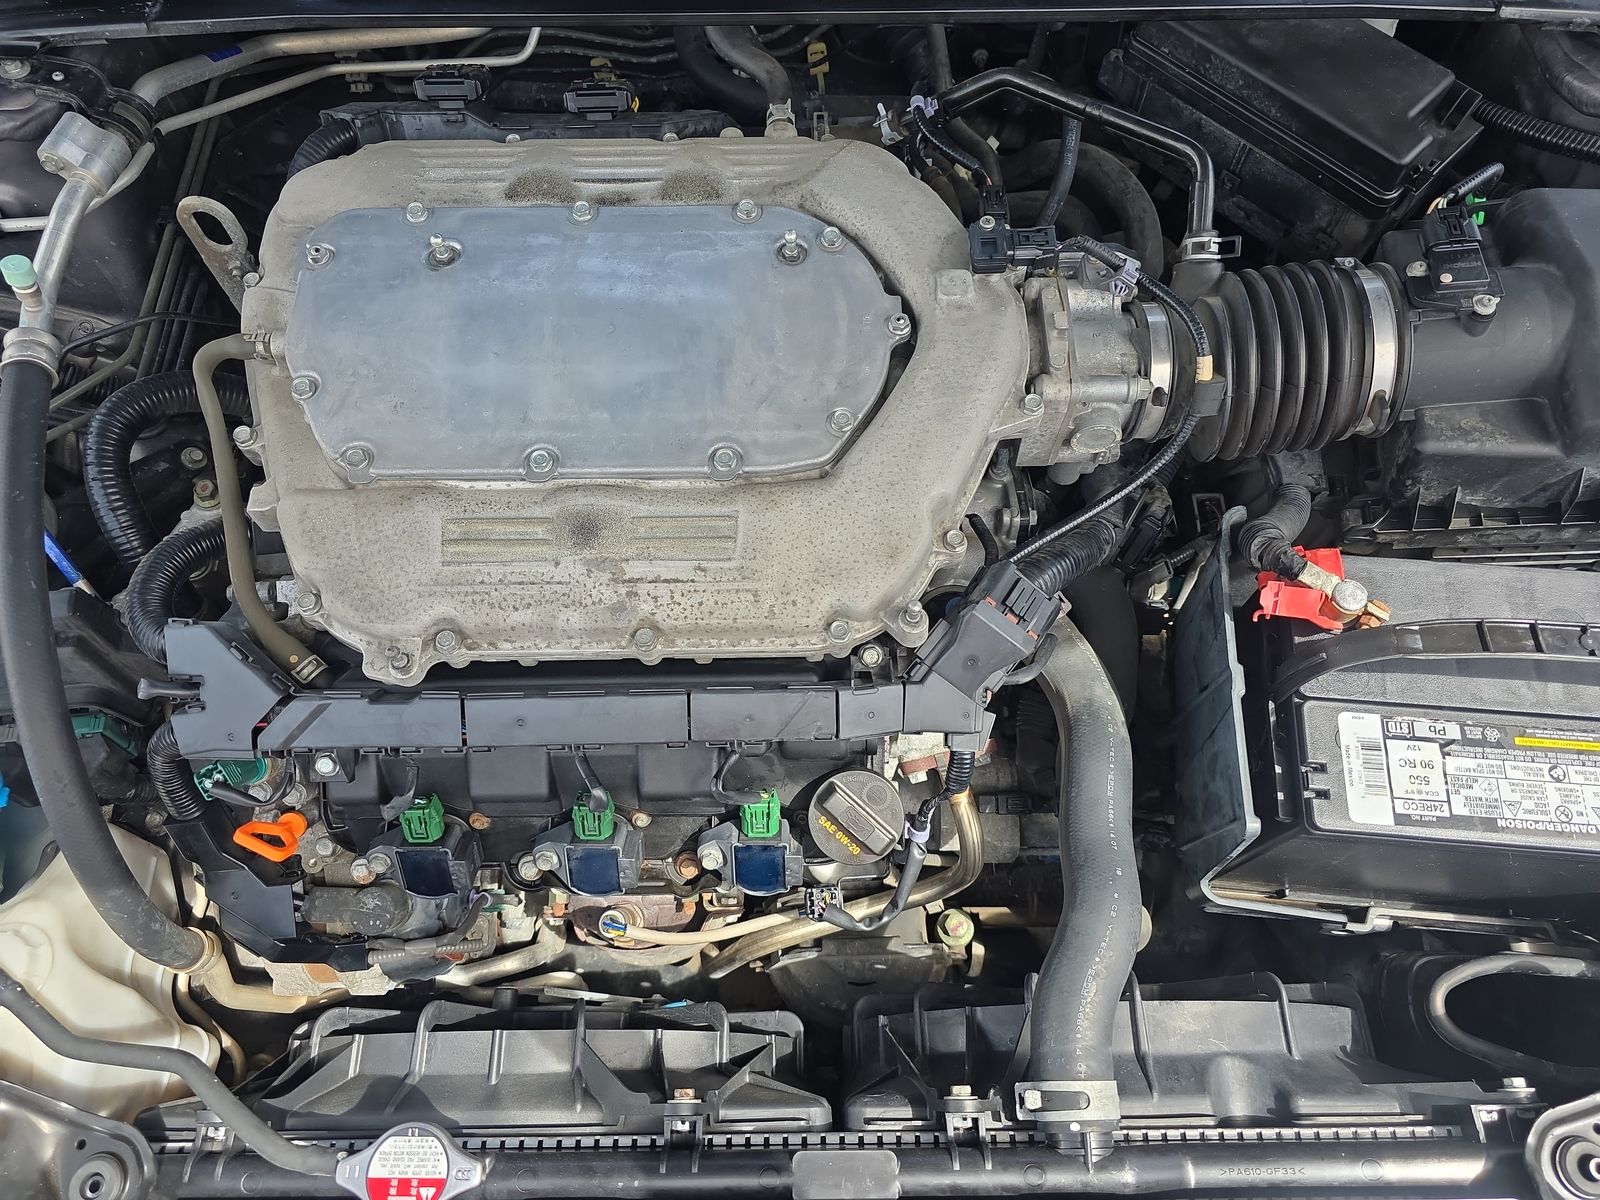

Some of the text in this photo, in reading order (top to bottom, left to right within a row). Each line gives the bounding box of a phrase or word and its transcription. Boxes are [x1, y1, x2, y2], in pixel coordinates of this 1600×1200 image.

[1388, 722, 1409, 733] STD
[1428, 725, 1446, 736] Pb
[1406, 744, 1421, 752] 12V
[1398, 758, 1434, 770] 90 RC
[842, 775, 868, 783] ENGINE
[1408, 774, 1430, 785] 550
[1402, 801, 1445, 812] 24RECO
[1522, 808, 1549, 816] SULFURIC
[1496, 818, 1596, 834] DANGER/POISON
[818, 815, 861, 855] SAE 0W-20
[1110, 904, 1118, 918] C2
[1097, 924, 1113, 955] Y-TEC
[1220, 1167, 1305, 1176] >PA610-GF33<
